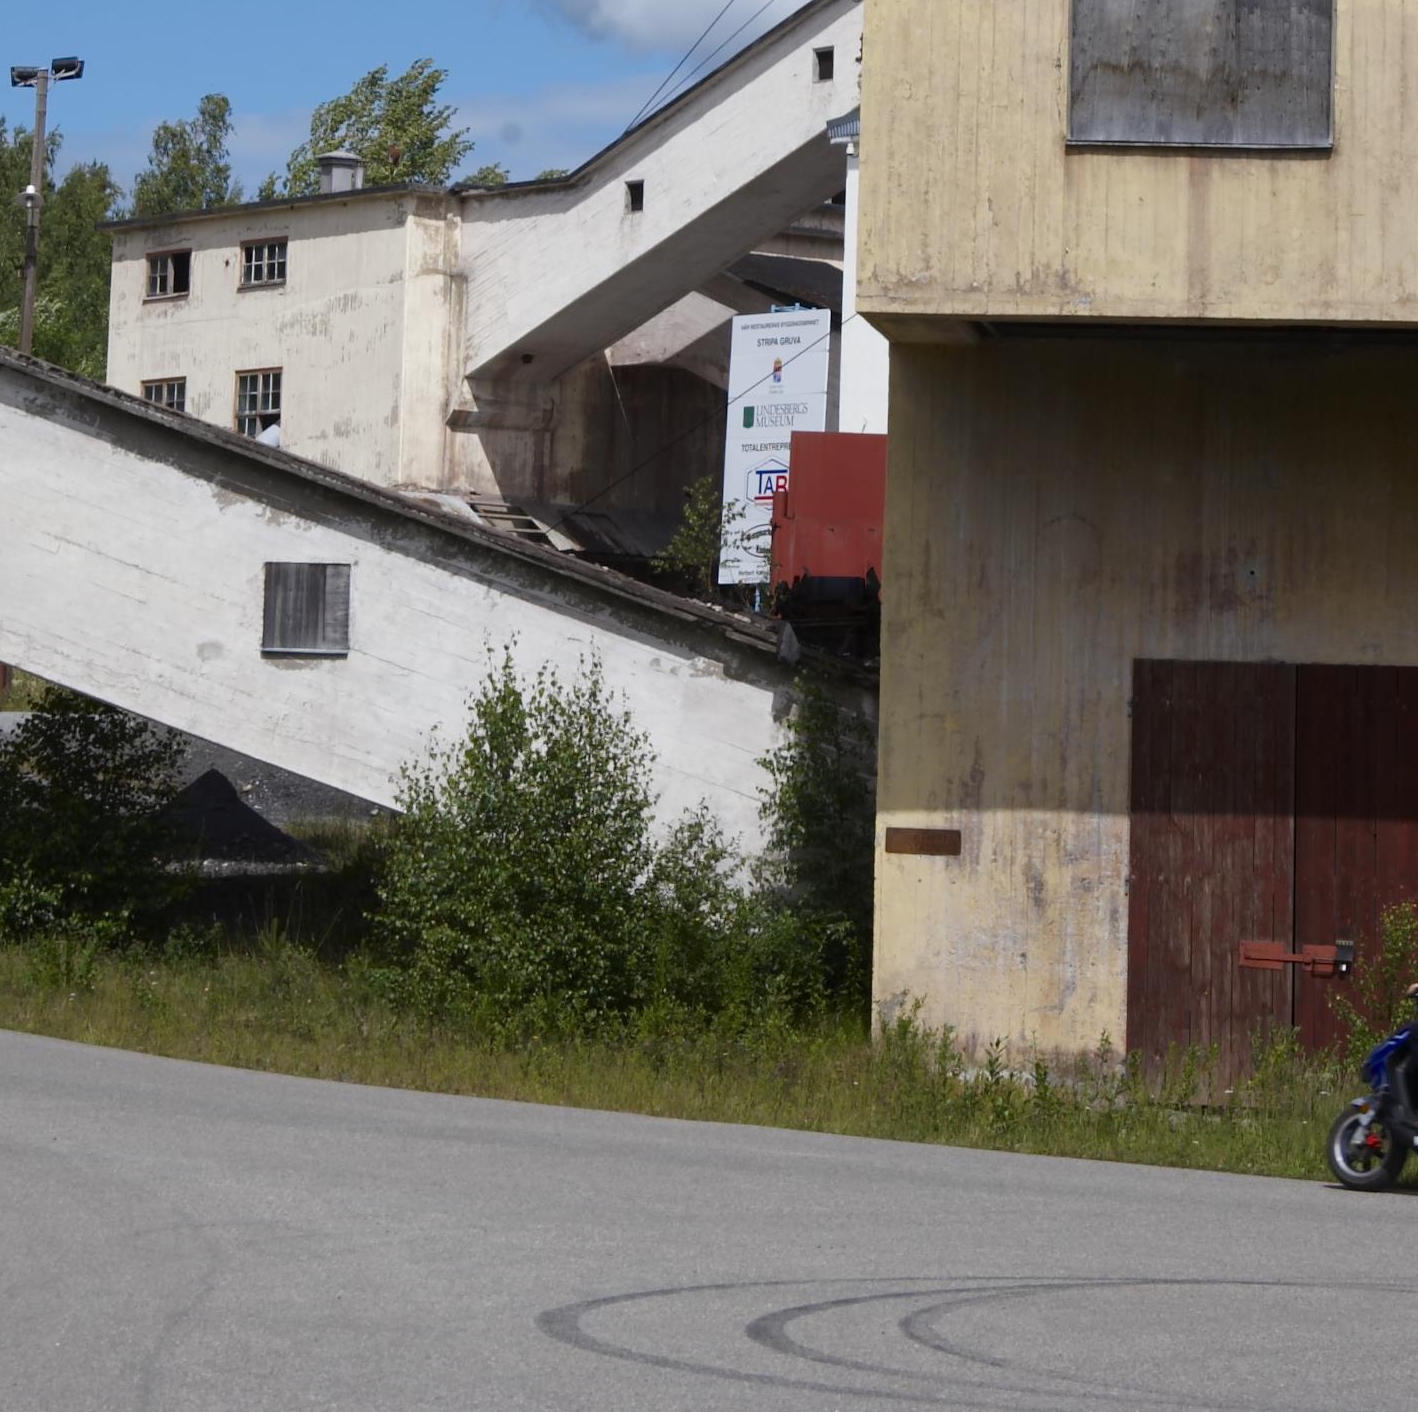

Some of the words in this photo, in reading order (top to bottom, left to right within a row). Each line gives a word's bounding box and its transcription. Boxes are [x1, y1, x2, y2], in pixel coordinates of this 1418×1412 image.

[757, 338, 779, 347] STRIPA
[780, 336, 801, 346] GRUVA
[756, 402, 809, 416] LINDESBERGS
[756, 415, 794, 428] MUSEUM
